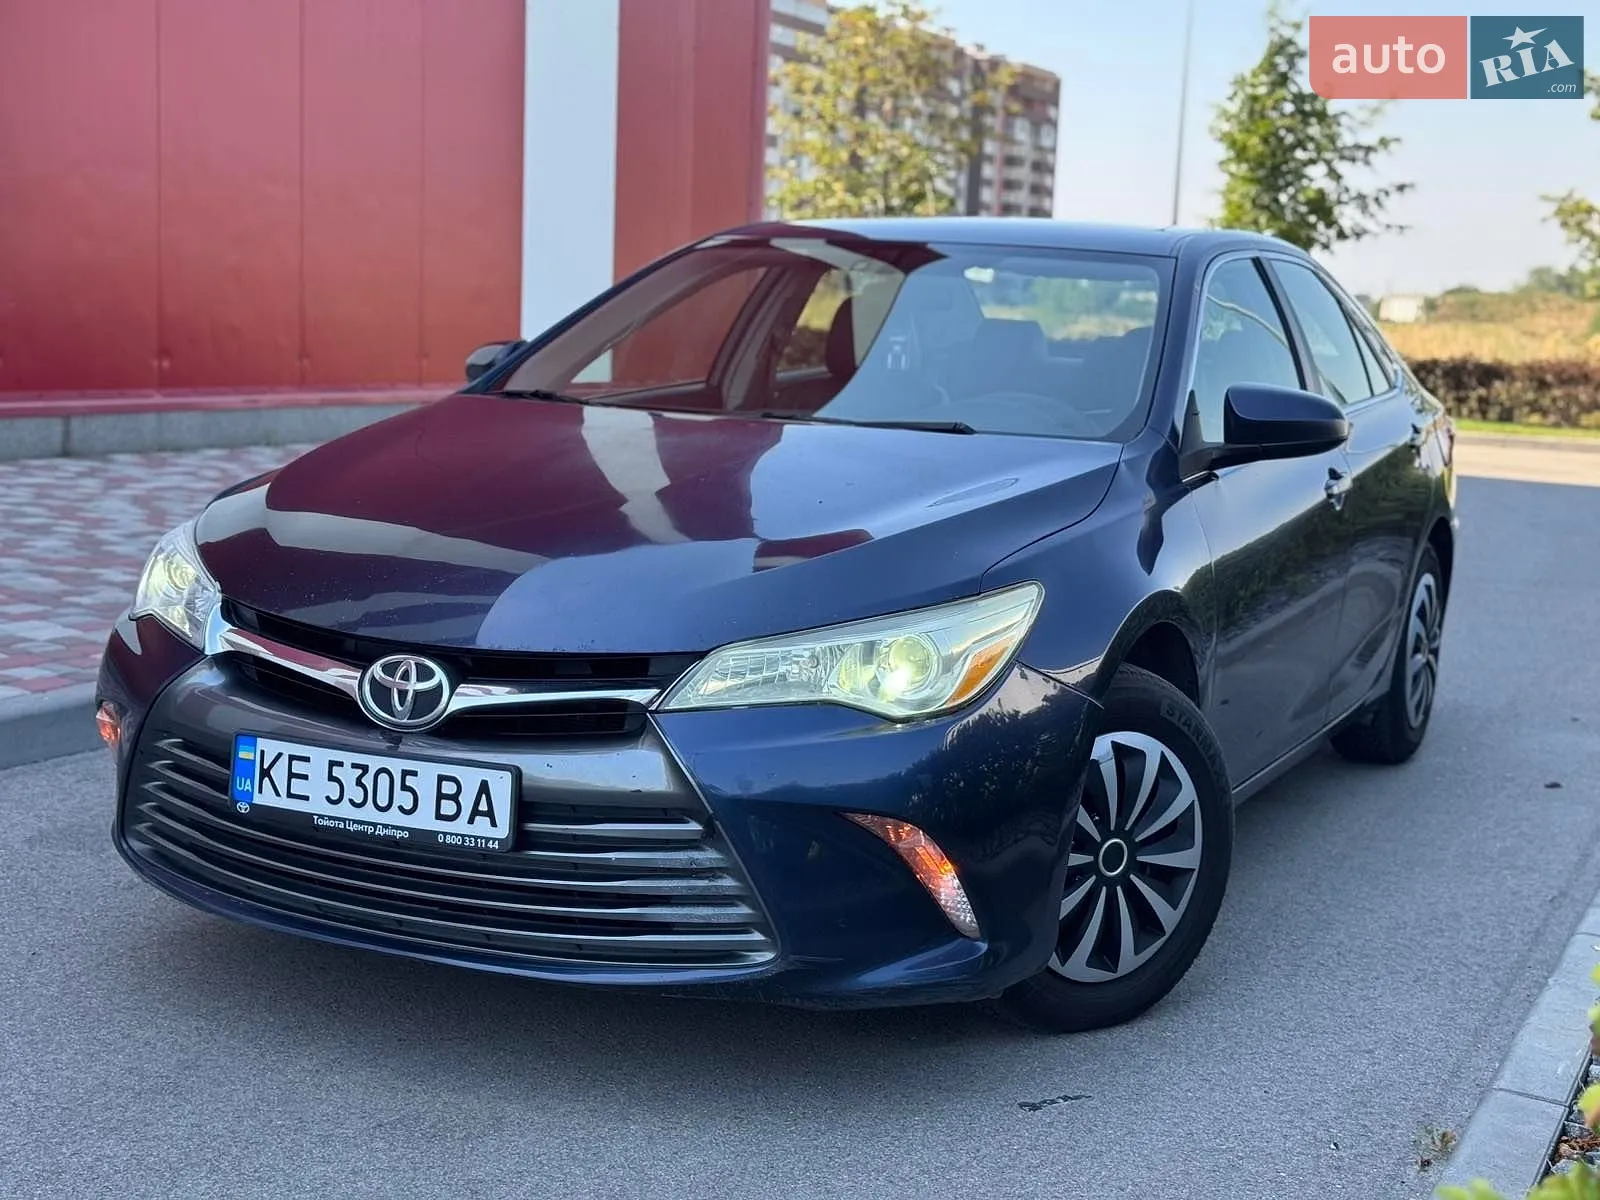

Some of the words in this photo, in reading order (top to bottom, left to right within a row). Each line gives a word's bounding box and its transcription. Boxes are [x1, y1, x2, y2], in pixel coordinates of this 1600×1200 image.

[236, 776, 252, 792] UA
[257, 749, 311, 802] KE
[324, 759, 420, 816] 5305
[434, 773, 498, 828] BA
[313, 815, 344, 829] Тойота
[345, 820, 375, 835] Центр
[375, 825, 409, 839] Дніпро
[438, 833, 444, 843] 0
[445, 835, 462, 846] 800
[463, 837, 475, 847] 33
[476, 838, 486, 849] 11
[486, 839, 499, 850] 44
